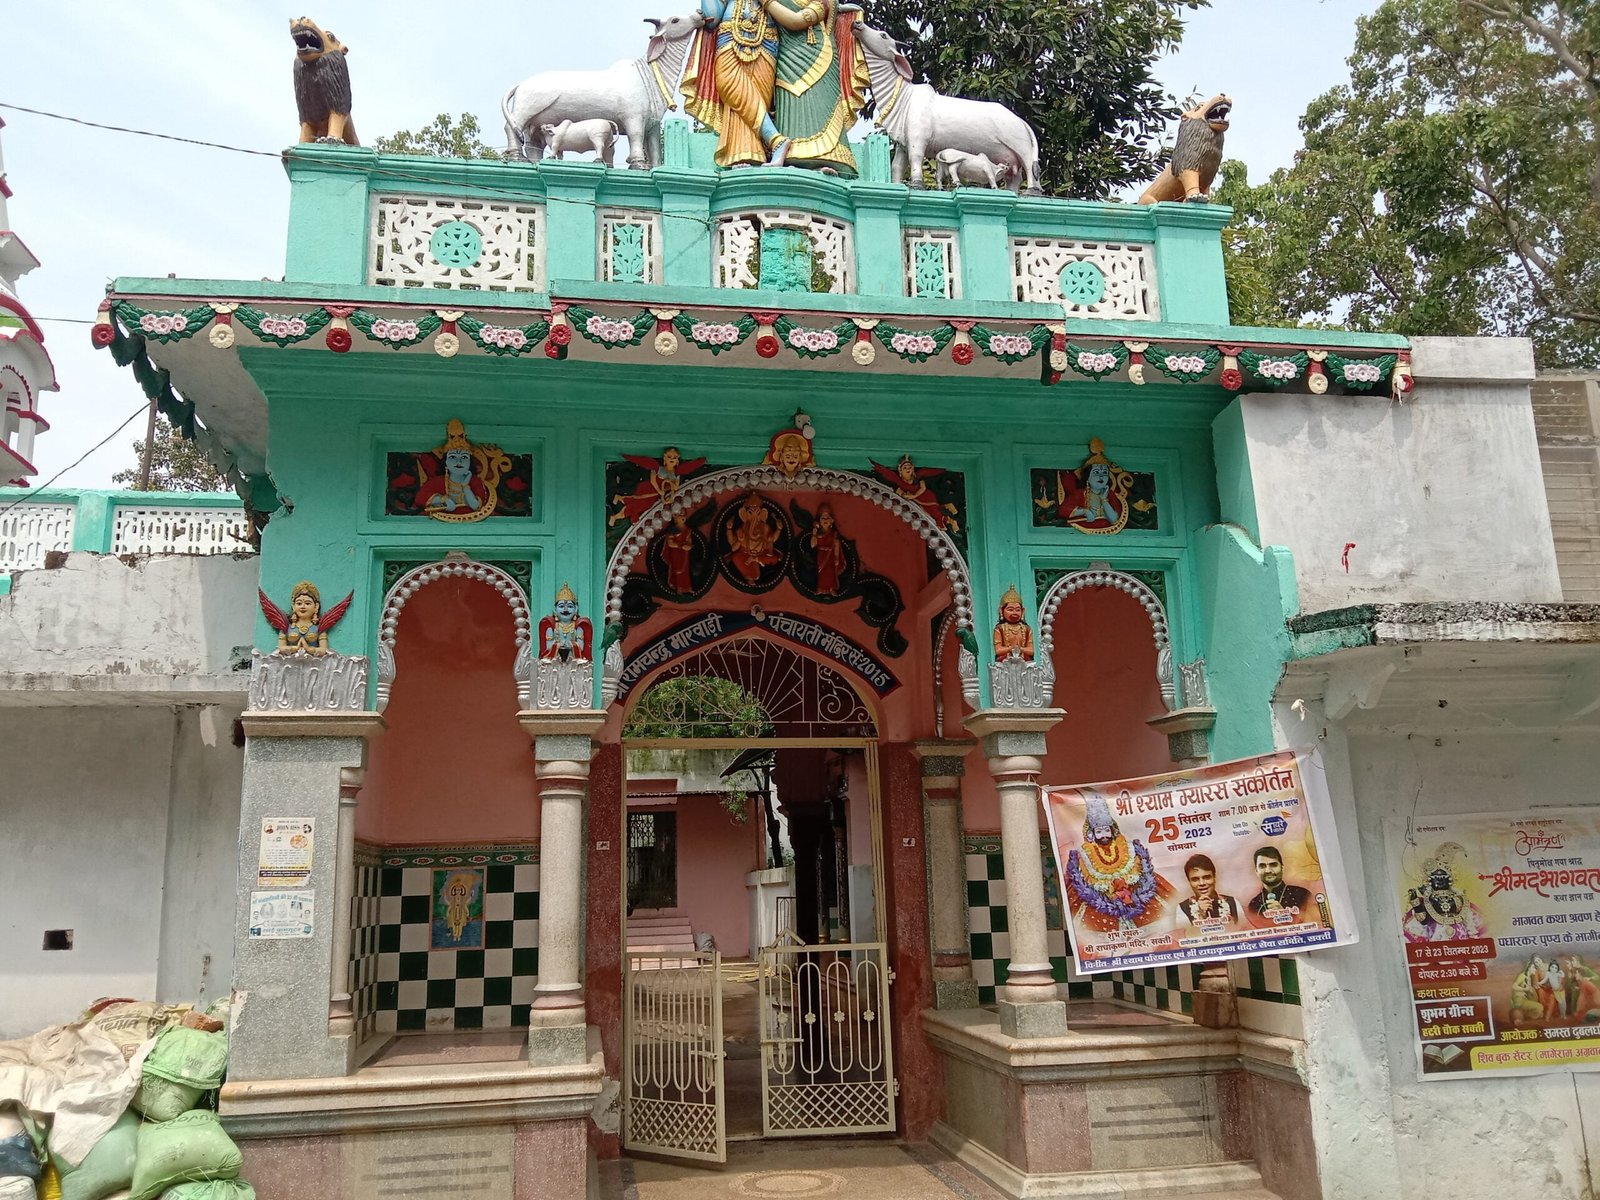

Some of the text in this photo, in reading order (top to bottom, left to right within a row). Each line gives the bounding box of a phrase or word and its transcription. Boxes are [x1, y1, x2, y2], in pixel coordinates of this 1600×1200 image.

[668, 612, 723, 650] मारवाड़ी
[768, 612, 824, 646] पंचायती
[820, 632, 852, 662] मंदिर
[1116, 790, 1133, 816] श्री
[1136, 790, 1174, 813] श्याम
[1176, 781, 1229, 807] ग्यारस
[1232, 767, 1294, 797] संकीर्तन
[1230, 806, 1248, 816] 7.00
[1145, 812, 1213, 843] 25 सितंबर
[1185, 827, 1213, 839] 2023
[1168, 842, 1197, 852] सोमवार
[1554, 894, 1568, 903] कथा
[1512, 914, 1544, 927] भागवत
[1545, 914, 1567, 925] कथा
[1569, 912, 1593, 924] श्रवण
[1108, 931, 1120, 941] शुभ
[1498, 935, 1538, 948] पधारकर
[1540, 934, 1561, 947] पुण्य
[1562, 930, 1573, 943] के
[1085, 944, 1094, 953] श्री
[1096, 942, 1127, 953] राधाकृष्ण
[1150, 936, 1171, 946] सक्ती
[1112, 958, 1122, 967] श्री
[1122, 957, 1143, 966] श्याम
[1144, 954, 1172, 963] परिवार
[1174, 951, 1185, 960] एवं
[1186, 948, 1197, 958] श्री
[1199, 946, 1236, 956] राधाकृष्ण
[1237, 942, 1258, 952] मंदिर
[1259, 940, 1276, 949] सेवा
[1307, 932, 1332, 942] सक्ती
[1415, 944, 1489, 959] 17 से 23 सितम्बर 2023
[1418, 966, 1479, 980] दोपहर 2:30 बजे से
[1416, 989, 1437, 999] कथा
[1438, 988, 1461, 998] स्थल
[1420, 1004, 1474, 1025] शुभम ग्रीन्स
[1442, 1022, 1461, 1035] चौक
[1500, 1028, 1538, 1042] आयोजक
[1544, 1027, 1571, 1040] समस्त
[1478, 1051, 1494, 1064] शिव
[1496, 1052, 1511, 1065] बुक
